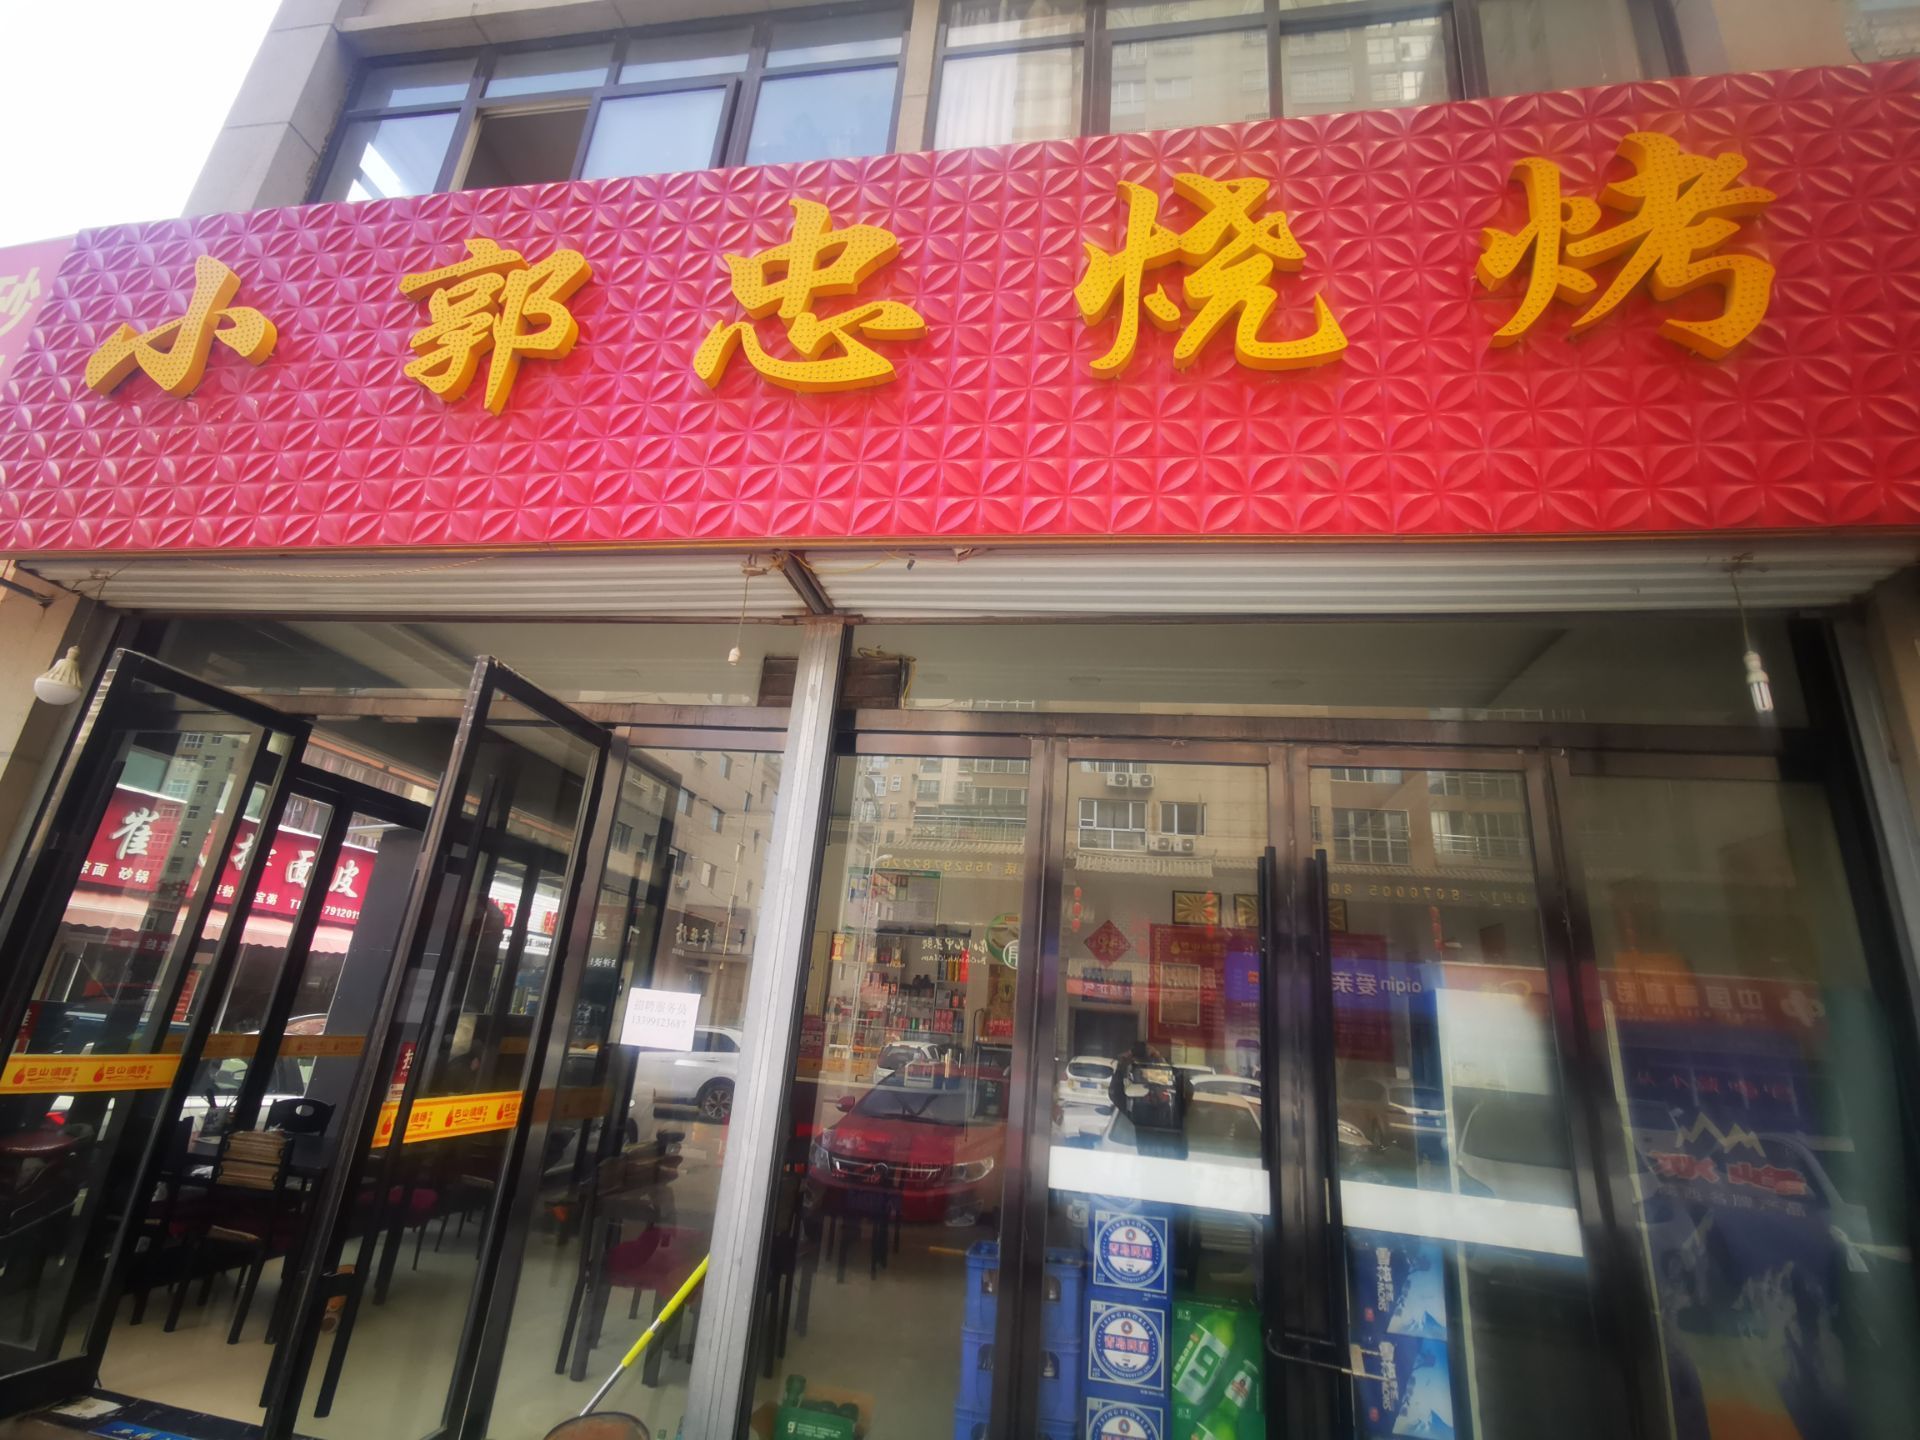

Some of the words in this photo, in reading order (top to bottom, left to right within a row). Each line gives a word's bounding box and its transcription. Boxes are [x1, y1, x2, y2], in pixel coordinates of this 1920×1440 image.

[85, 131, 1777, 416] 小郭忠烧烤
